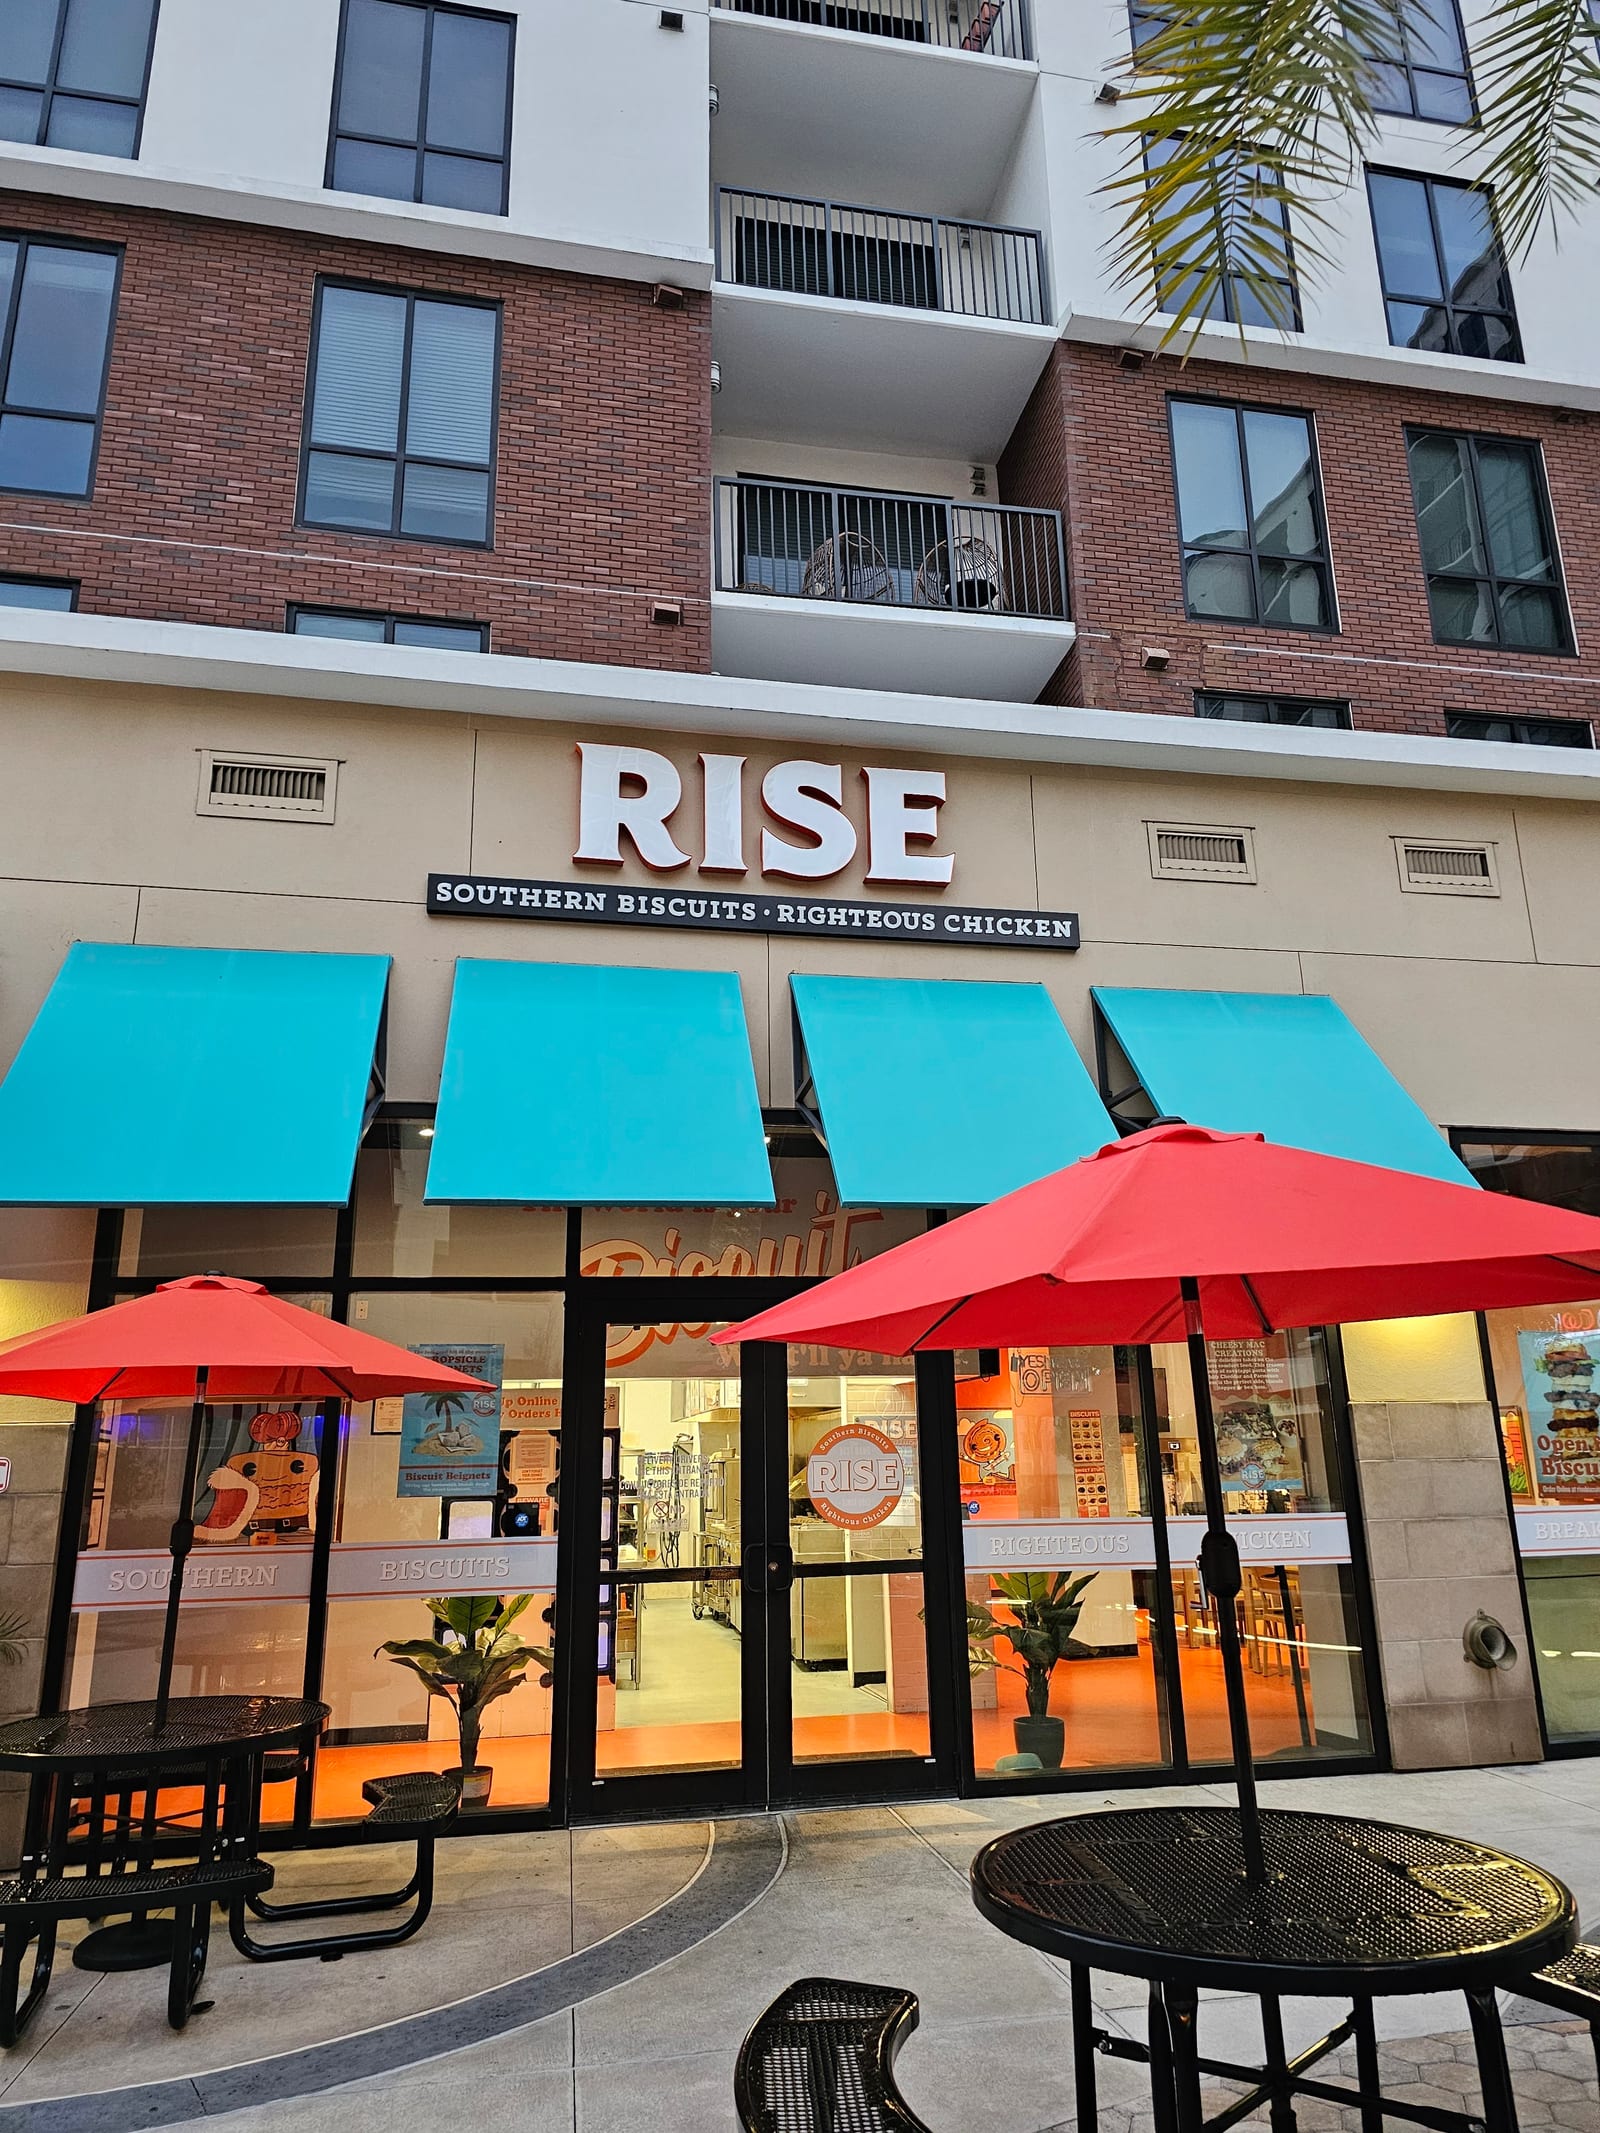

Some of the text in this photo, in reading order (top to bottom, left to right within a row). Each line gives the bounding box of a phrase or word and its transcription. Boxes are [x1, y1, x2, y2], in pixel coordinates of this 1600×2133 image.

[572, 742, 956, 888] RISE
[435, 881, 1072, 940] SOUTHERN BISCUITS RIGHTEOUS CHICKEN
[1211, 1341, 1243, 1349] CHEESY
[1215, 1349, 1263, 1357] CREATIONS
[428, 1355, 487, 1366] ROPSICLE
[473, 1400, 497, 1409] RISE
[517, 1396, 558, 1407] Online
[508, 1409, 551, 1419] Orders
[1070, 1410, 1100, 1418] BISCUITS
[820, 1428, 889, 1452] Southern Biscuits
[1537, 1435, 1590, 1456] Open
[405, 1471, 491, 1481] Biscuit Beignets
[652, 1466, 671, 1476] THIS
[812, 1459, 899, 1493] RISE
[1241, 1470, 1265, 1479] RISE
[820, 1501, 892, 1525] Righteous Chicken
[989, 1530, 1312, 1557] RIGHTEOUS ICKEN
[379, 1557, 510, 1581] BISCUITS
